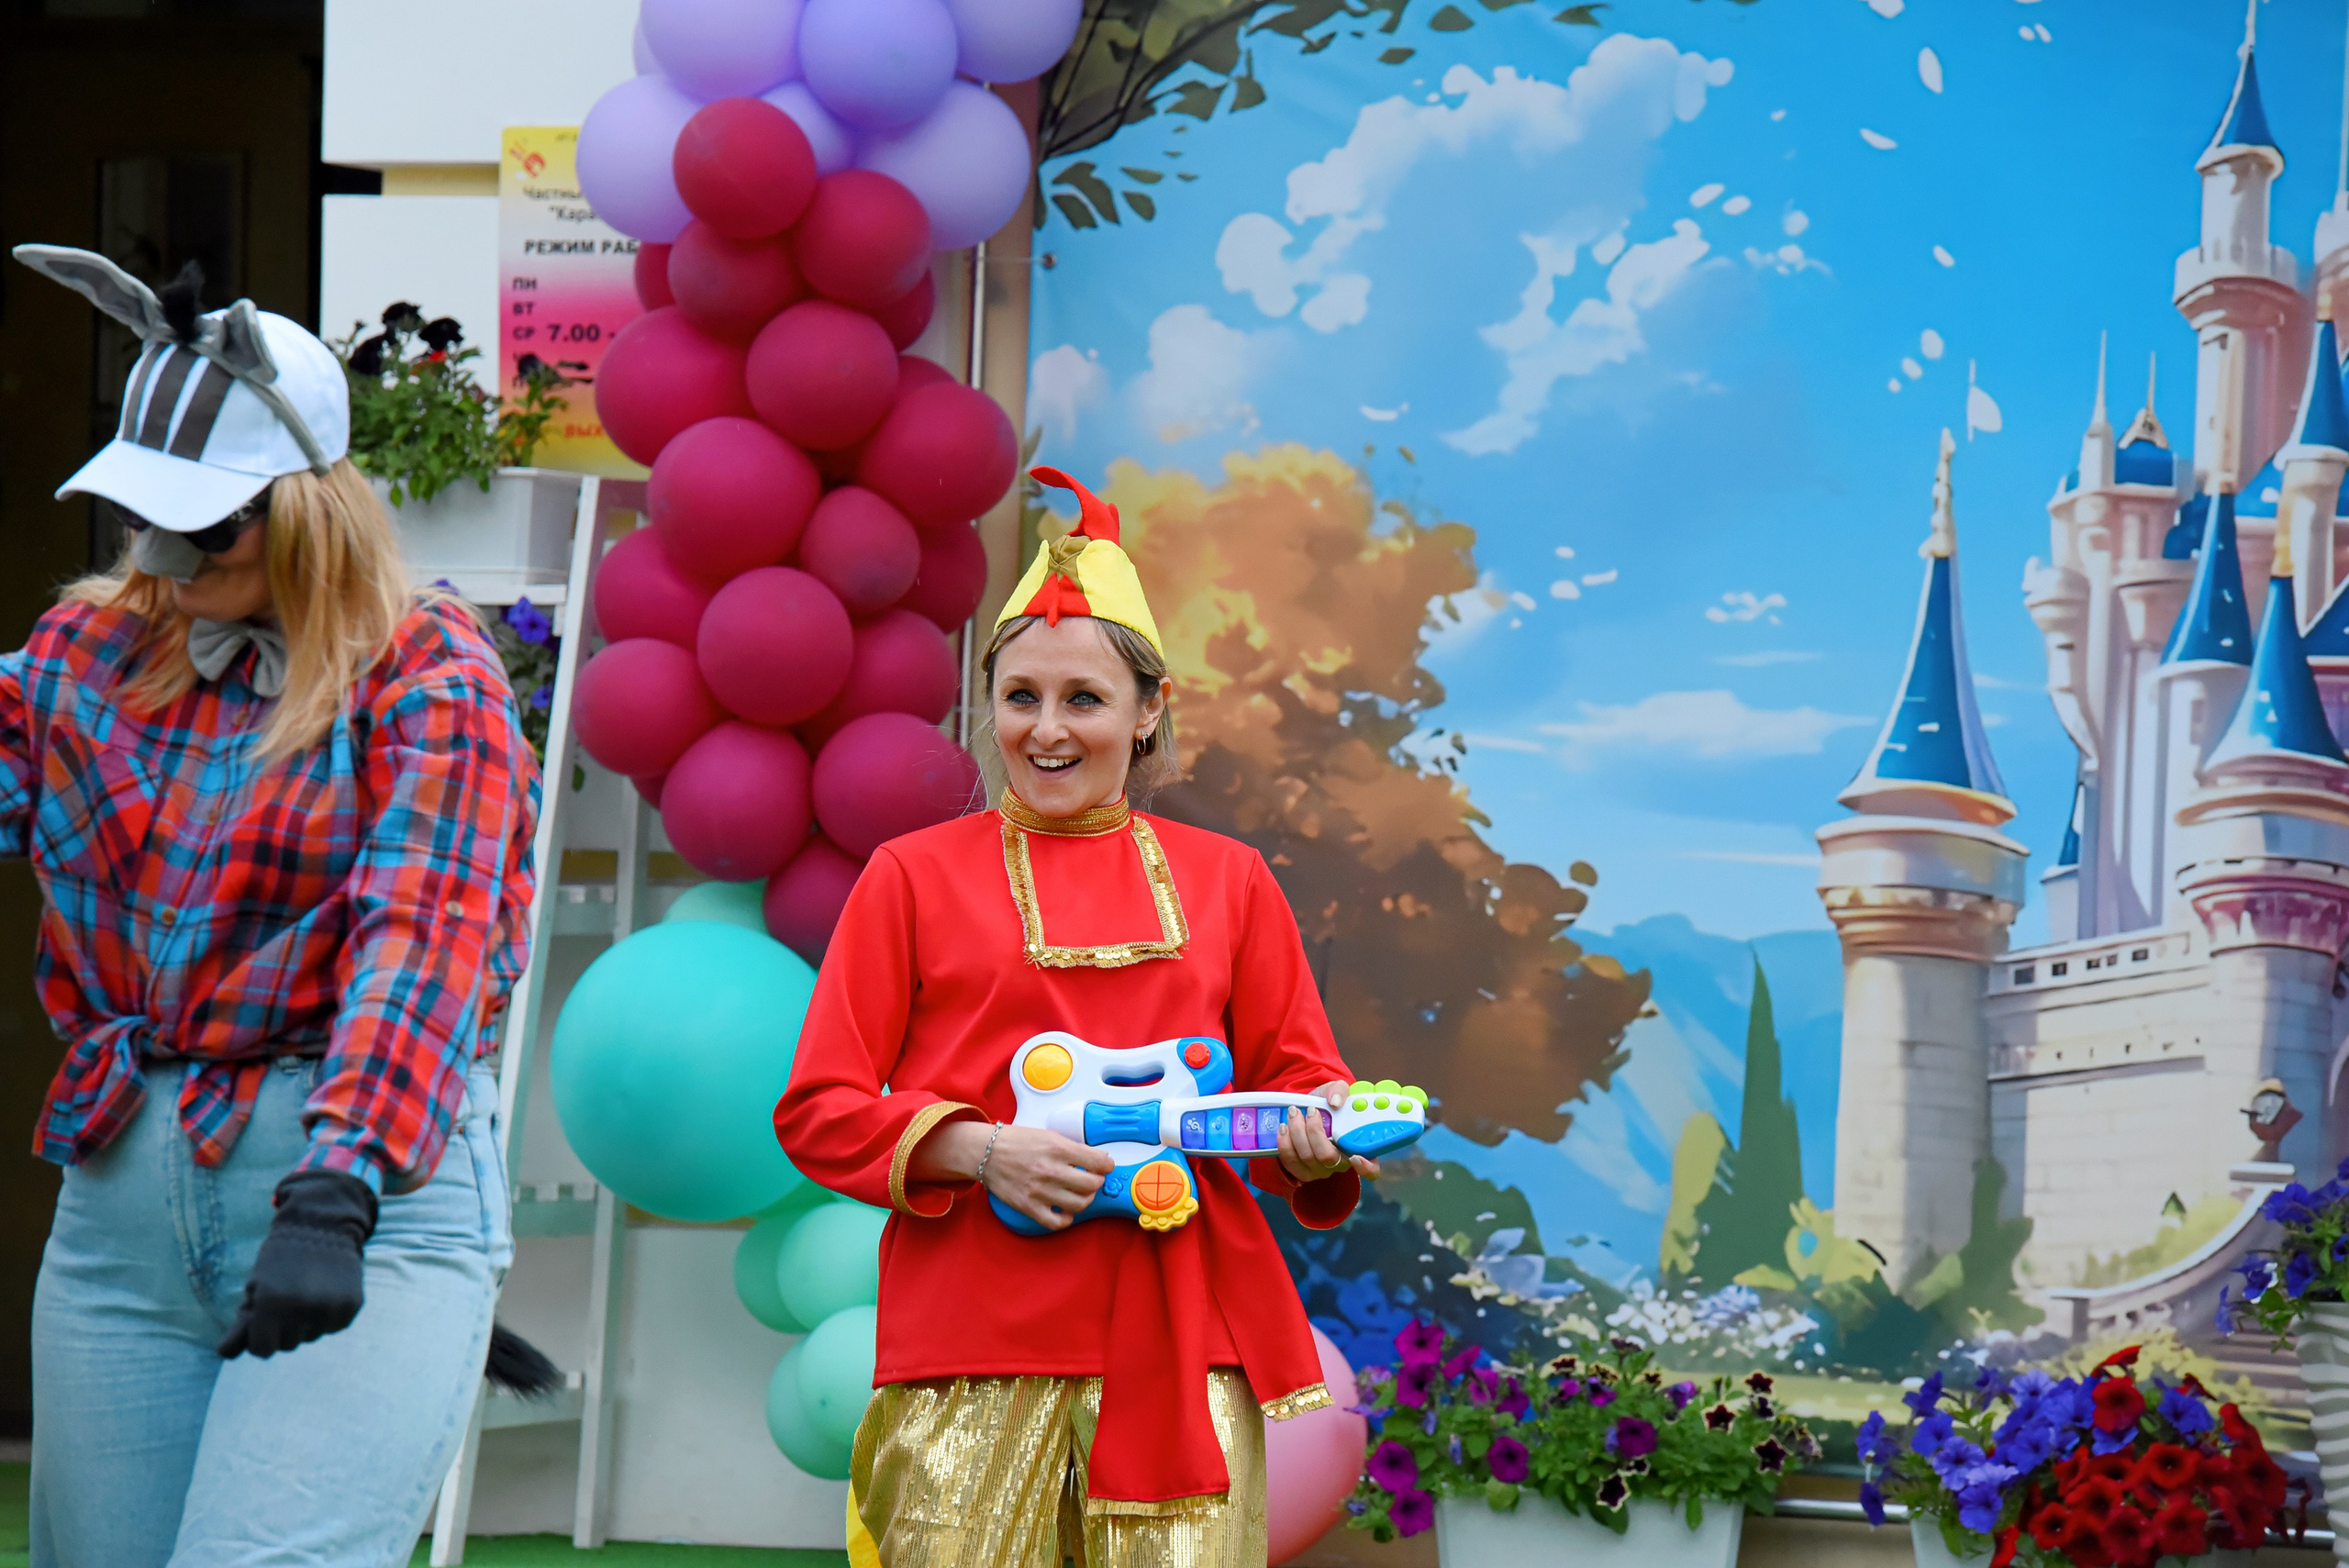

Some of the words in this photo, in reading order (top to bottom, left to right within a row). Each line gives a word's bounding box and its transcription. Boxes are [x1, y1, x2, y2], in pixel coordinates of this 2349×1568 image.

[524, 239, 596, 254] РЕЖИМ
[512, 277, 537, 290] ПН
[512, 302, 534, 315] ВТ
[512, 326, 535, 339] СР
[548, 324, 600, 341] 7.00
